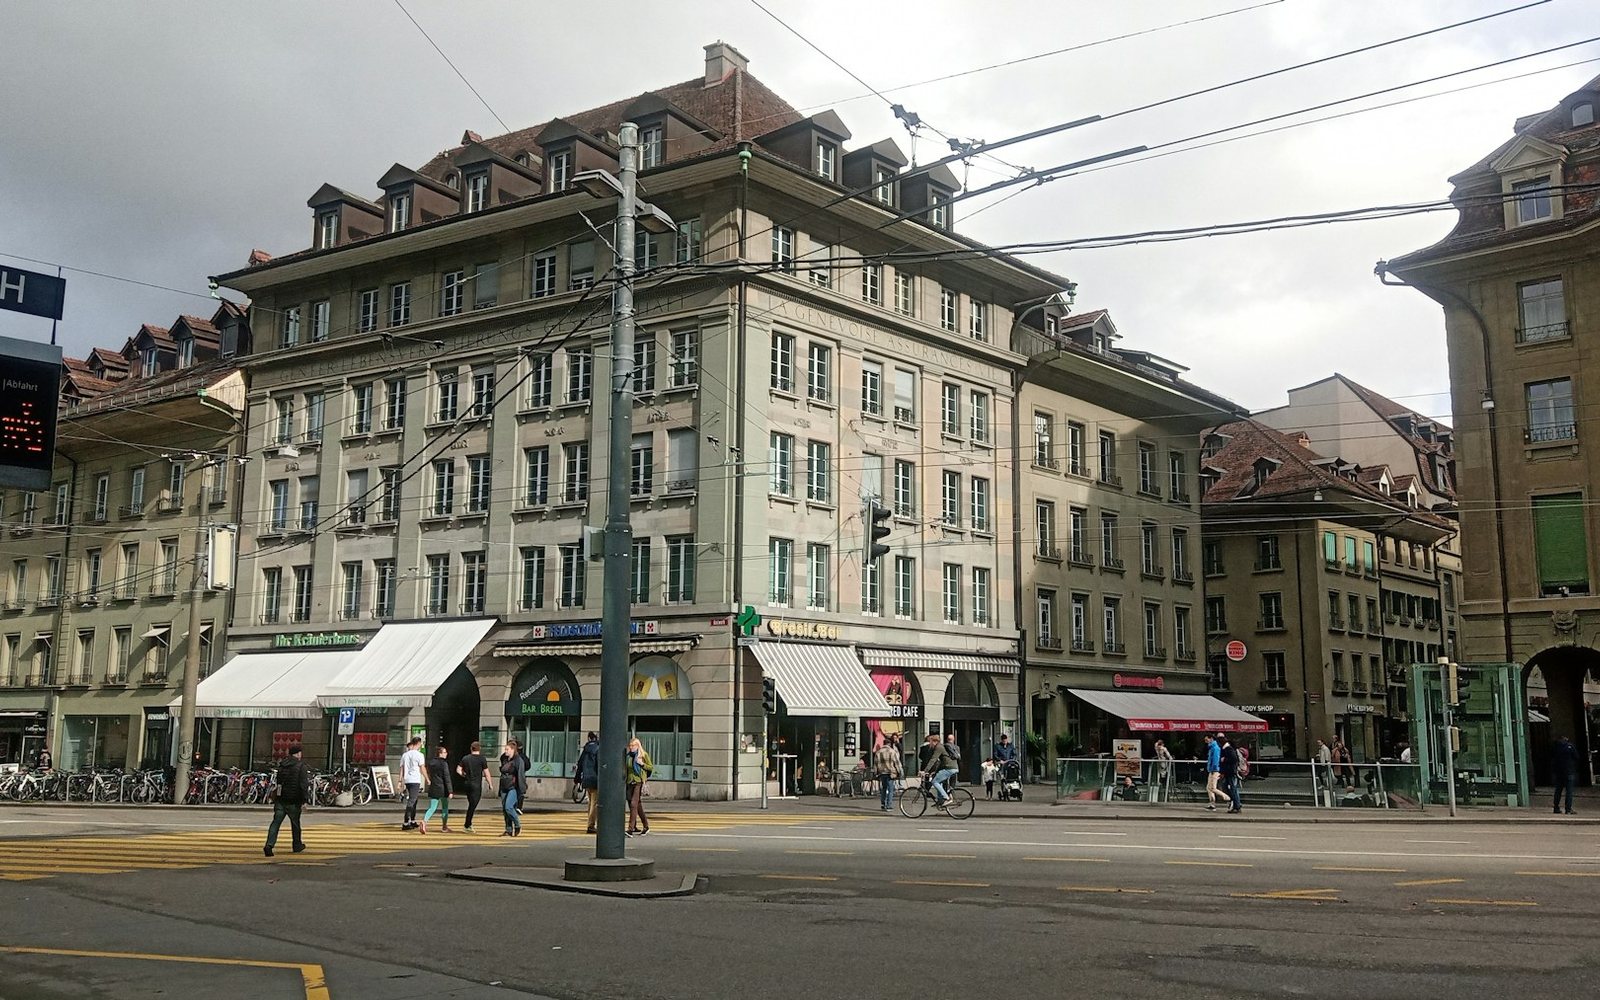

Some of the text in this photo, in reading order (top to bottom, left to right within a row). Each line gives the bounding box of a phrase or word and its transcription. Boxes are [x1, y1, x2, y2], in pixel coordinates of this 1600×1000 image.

[0, 270, 26, 304] H
[794, 303, 879, 344] GENEVOISE
[886, 335, 973, 374] ASSURANCES
[293, 632, 360, 646] Kräuterhaus
[519, 674, 549, 701] Restaurant
[902, 705, 919, 717] CAFE
